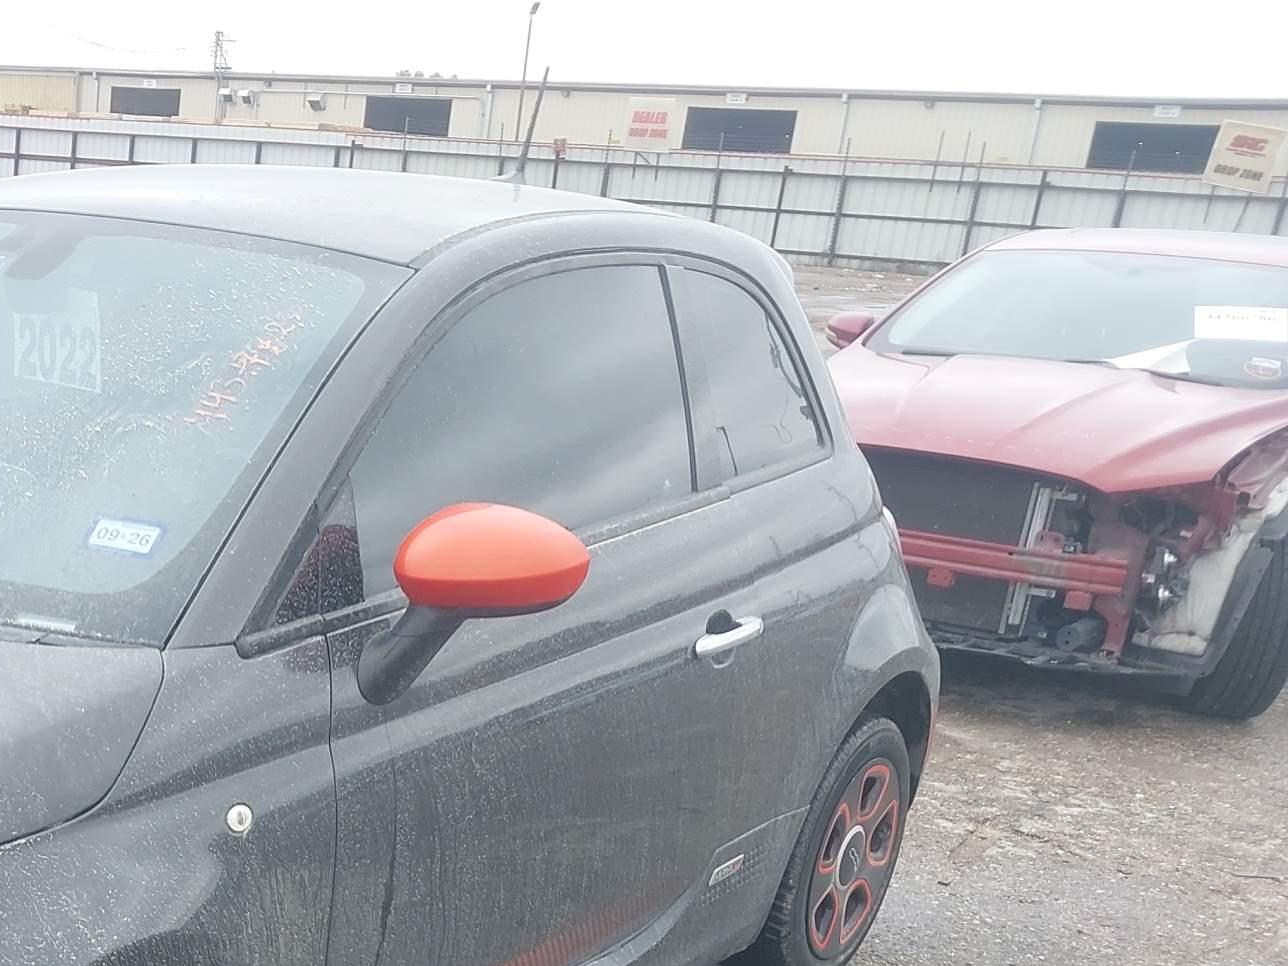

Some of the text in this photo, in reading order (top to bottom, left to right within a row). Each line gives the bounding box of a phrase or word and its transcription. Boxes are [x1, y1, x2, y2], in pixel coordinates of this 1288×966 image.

[632, 110, 668, 124] DEALER
[17, 318, 98, 389] 2022
[128, 532, 152, 546] 26
